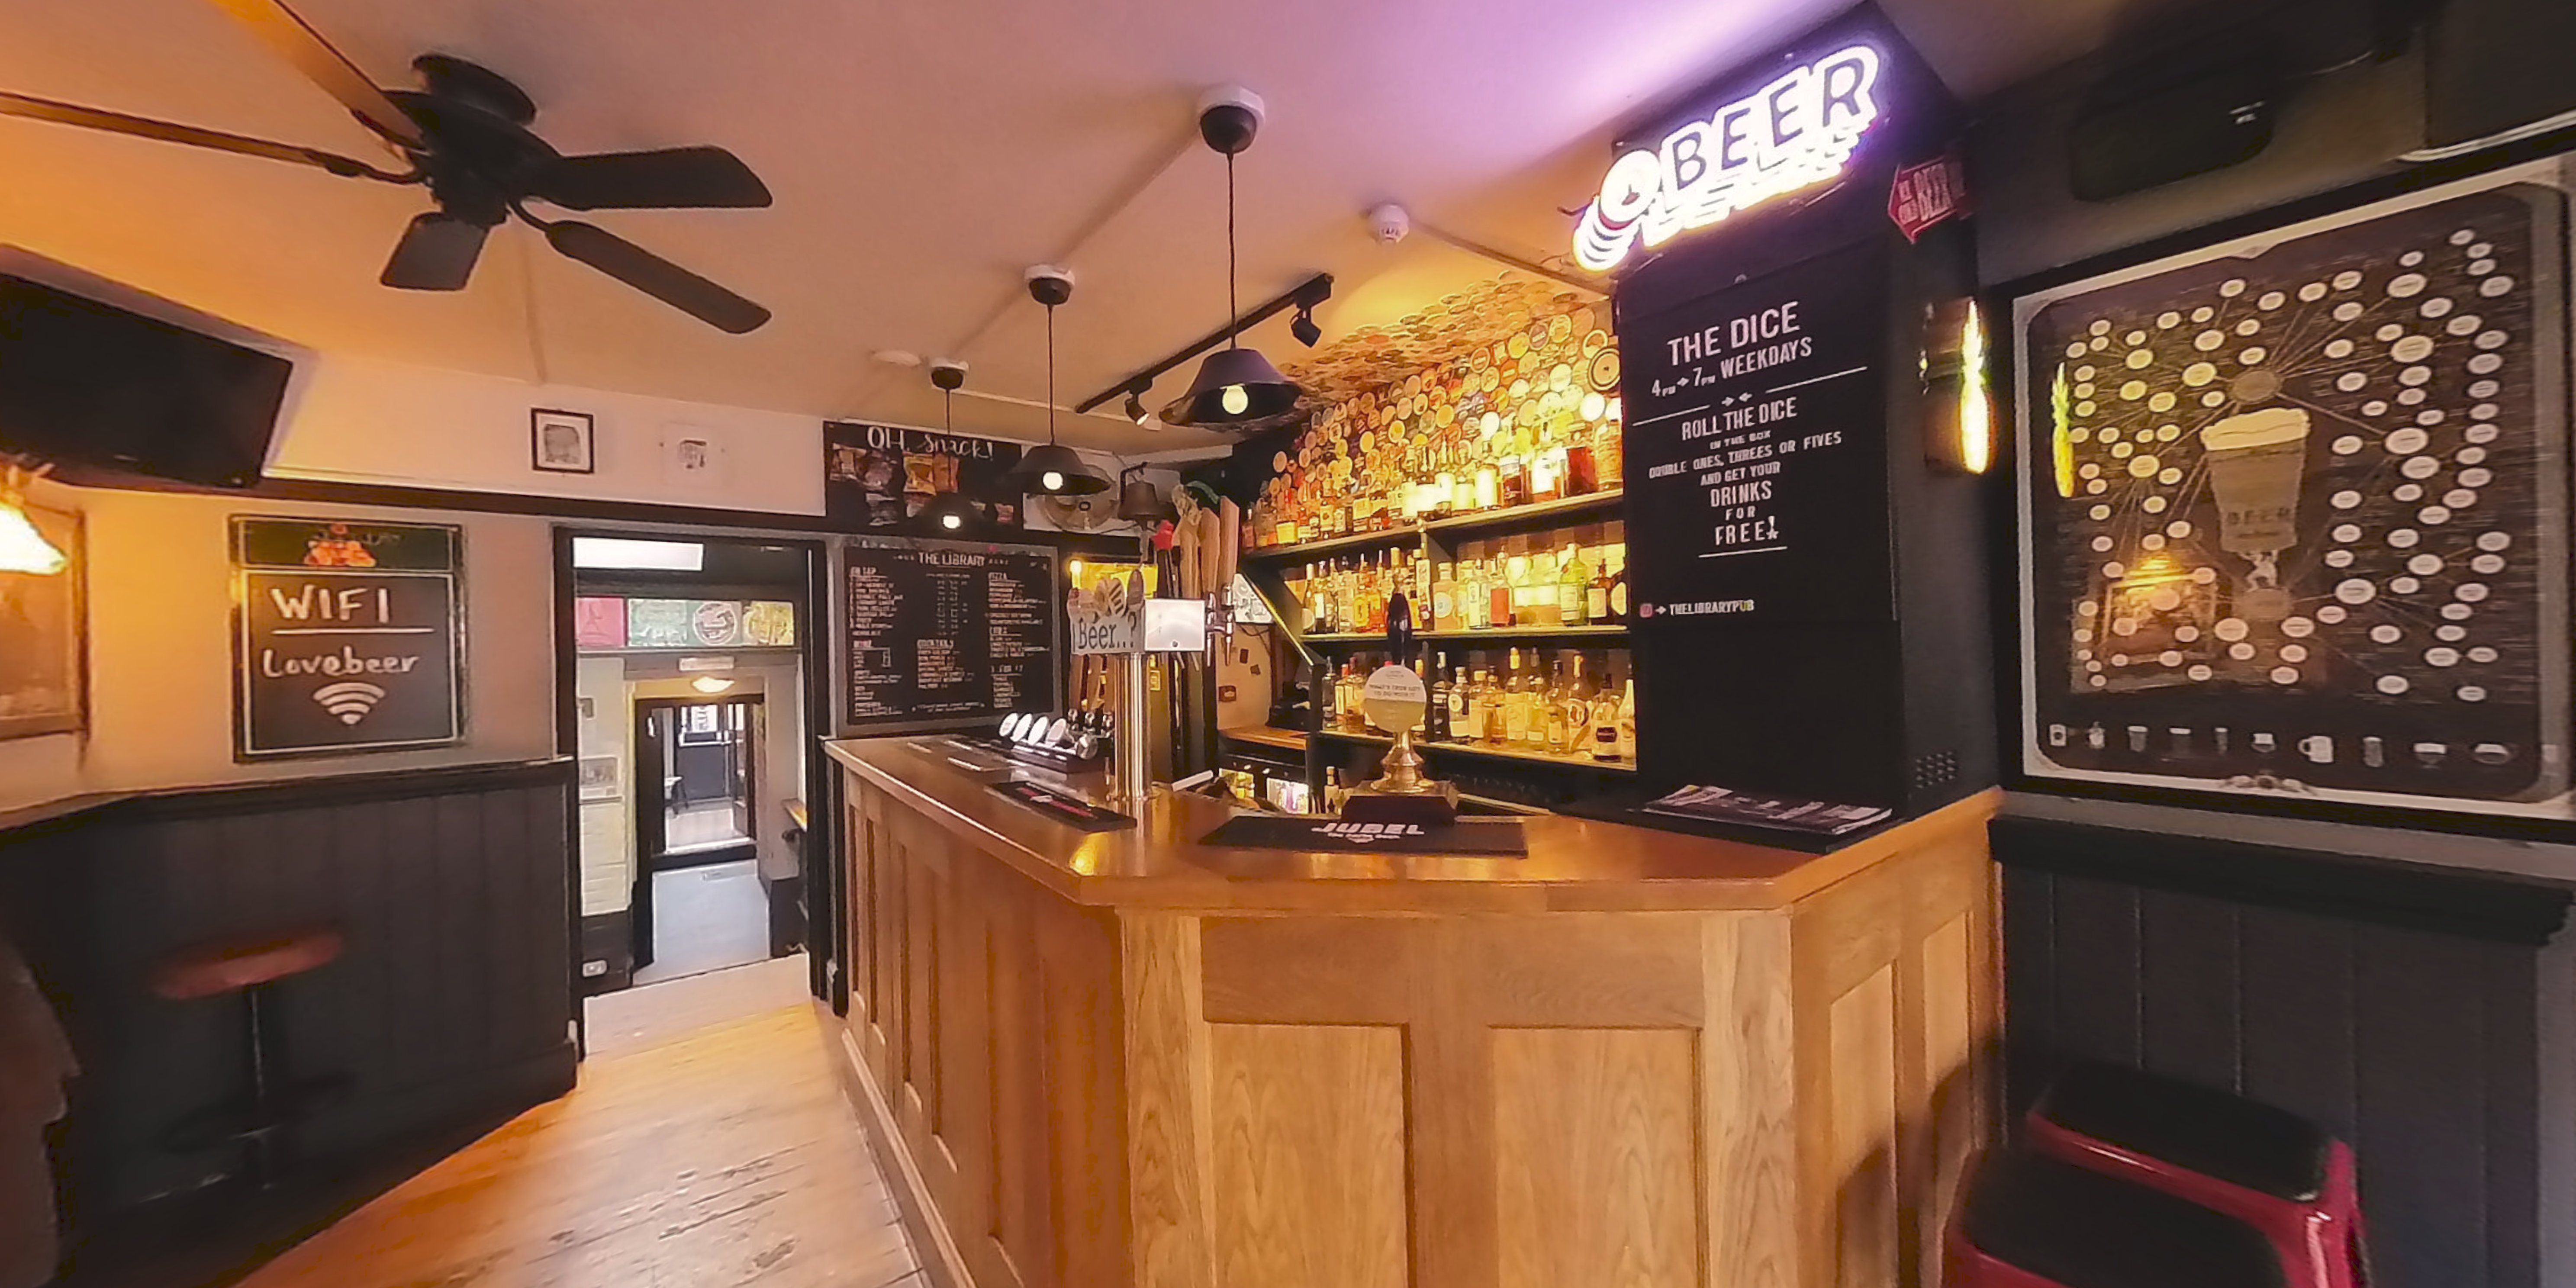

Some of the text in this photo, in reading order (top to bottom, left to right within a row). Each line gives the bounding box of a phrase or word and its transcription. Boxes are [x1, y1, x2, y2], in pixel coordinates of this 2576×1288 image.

[1666, 50, 1872, 196] BEER
[1667, 301, 1800, 366] THE DICE
[1720, 336, 1812, 379] WEEKDAYS
[1682, 397, 1797, 441] ROLL THE DICE
[1649, 461, 1687, 479] DOUBLE
[1728, 444, 1773, 465] THREES
[1779, 441, 1796, 454] OR
[1803, 431, 1842, 450] FIVES
[1710, 430, 1771, 450] IN THE BOX
[1700, 461, 1781, 486] AND GET YOUR
[1710, 480, 1772, 508] DRINKS
[1725, 506, 1756, 520] FOR
[918, 551, 940, 565] THE
[941, 553, 985, 567] LIBRARY
[270, 584, 389, 624] WIFI
[1669, 599, 1754, 615] THELIBRARYPUB
[263, 645, 419, 677] Lovebeer
